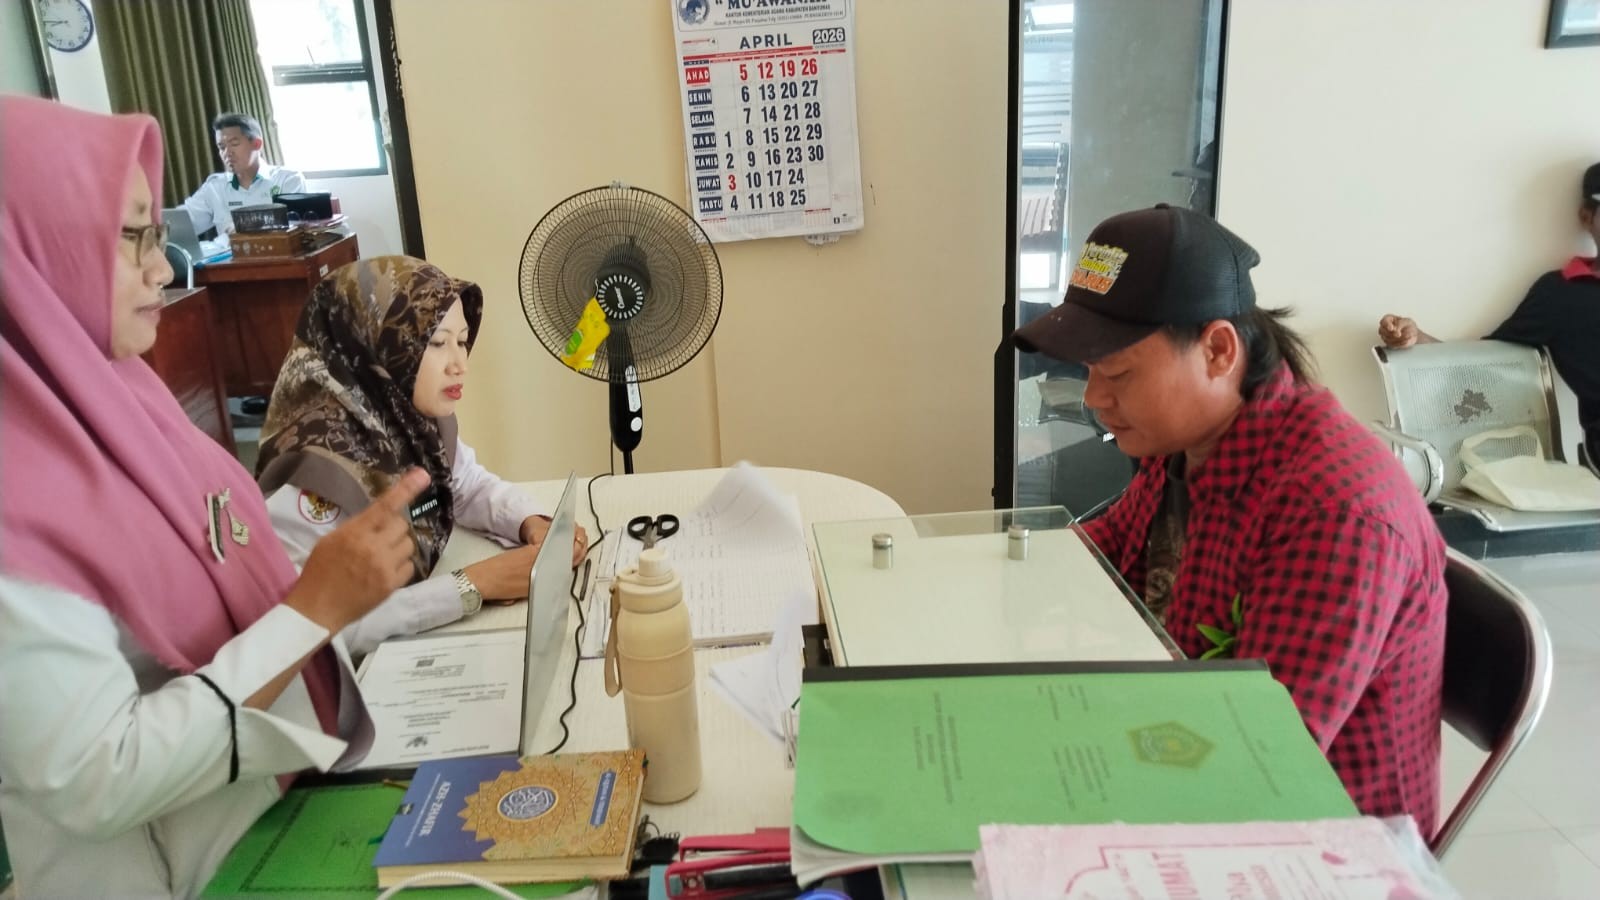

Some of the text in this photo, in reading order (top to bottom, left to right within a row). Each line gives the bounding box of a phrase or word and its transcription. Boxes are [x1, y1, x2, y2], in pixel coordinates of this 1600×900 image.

[739, 29, 845, 49] APRIL 2026
[686, 59, 817, 82] AHAD 5 12 19 26
[688, 80, 818, 104] SENIN 6 13 20 27
[691, 102, 821, 125] SELASA 7 14 21 28
[693, 124, 822, 148] RABU 1 8 15 22 29
[695, 145, 824, 169] KAMIS 2 9 16 23 30
[728, 175, 736, 191] 3
[746, 173, 761, 189] 10
[767, 170, 782, 186] 17
[788, 168, 804, 184] 24
[700, 189, 806, 211] SABTU 4 11 18 25
